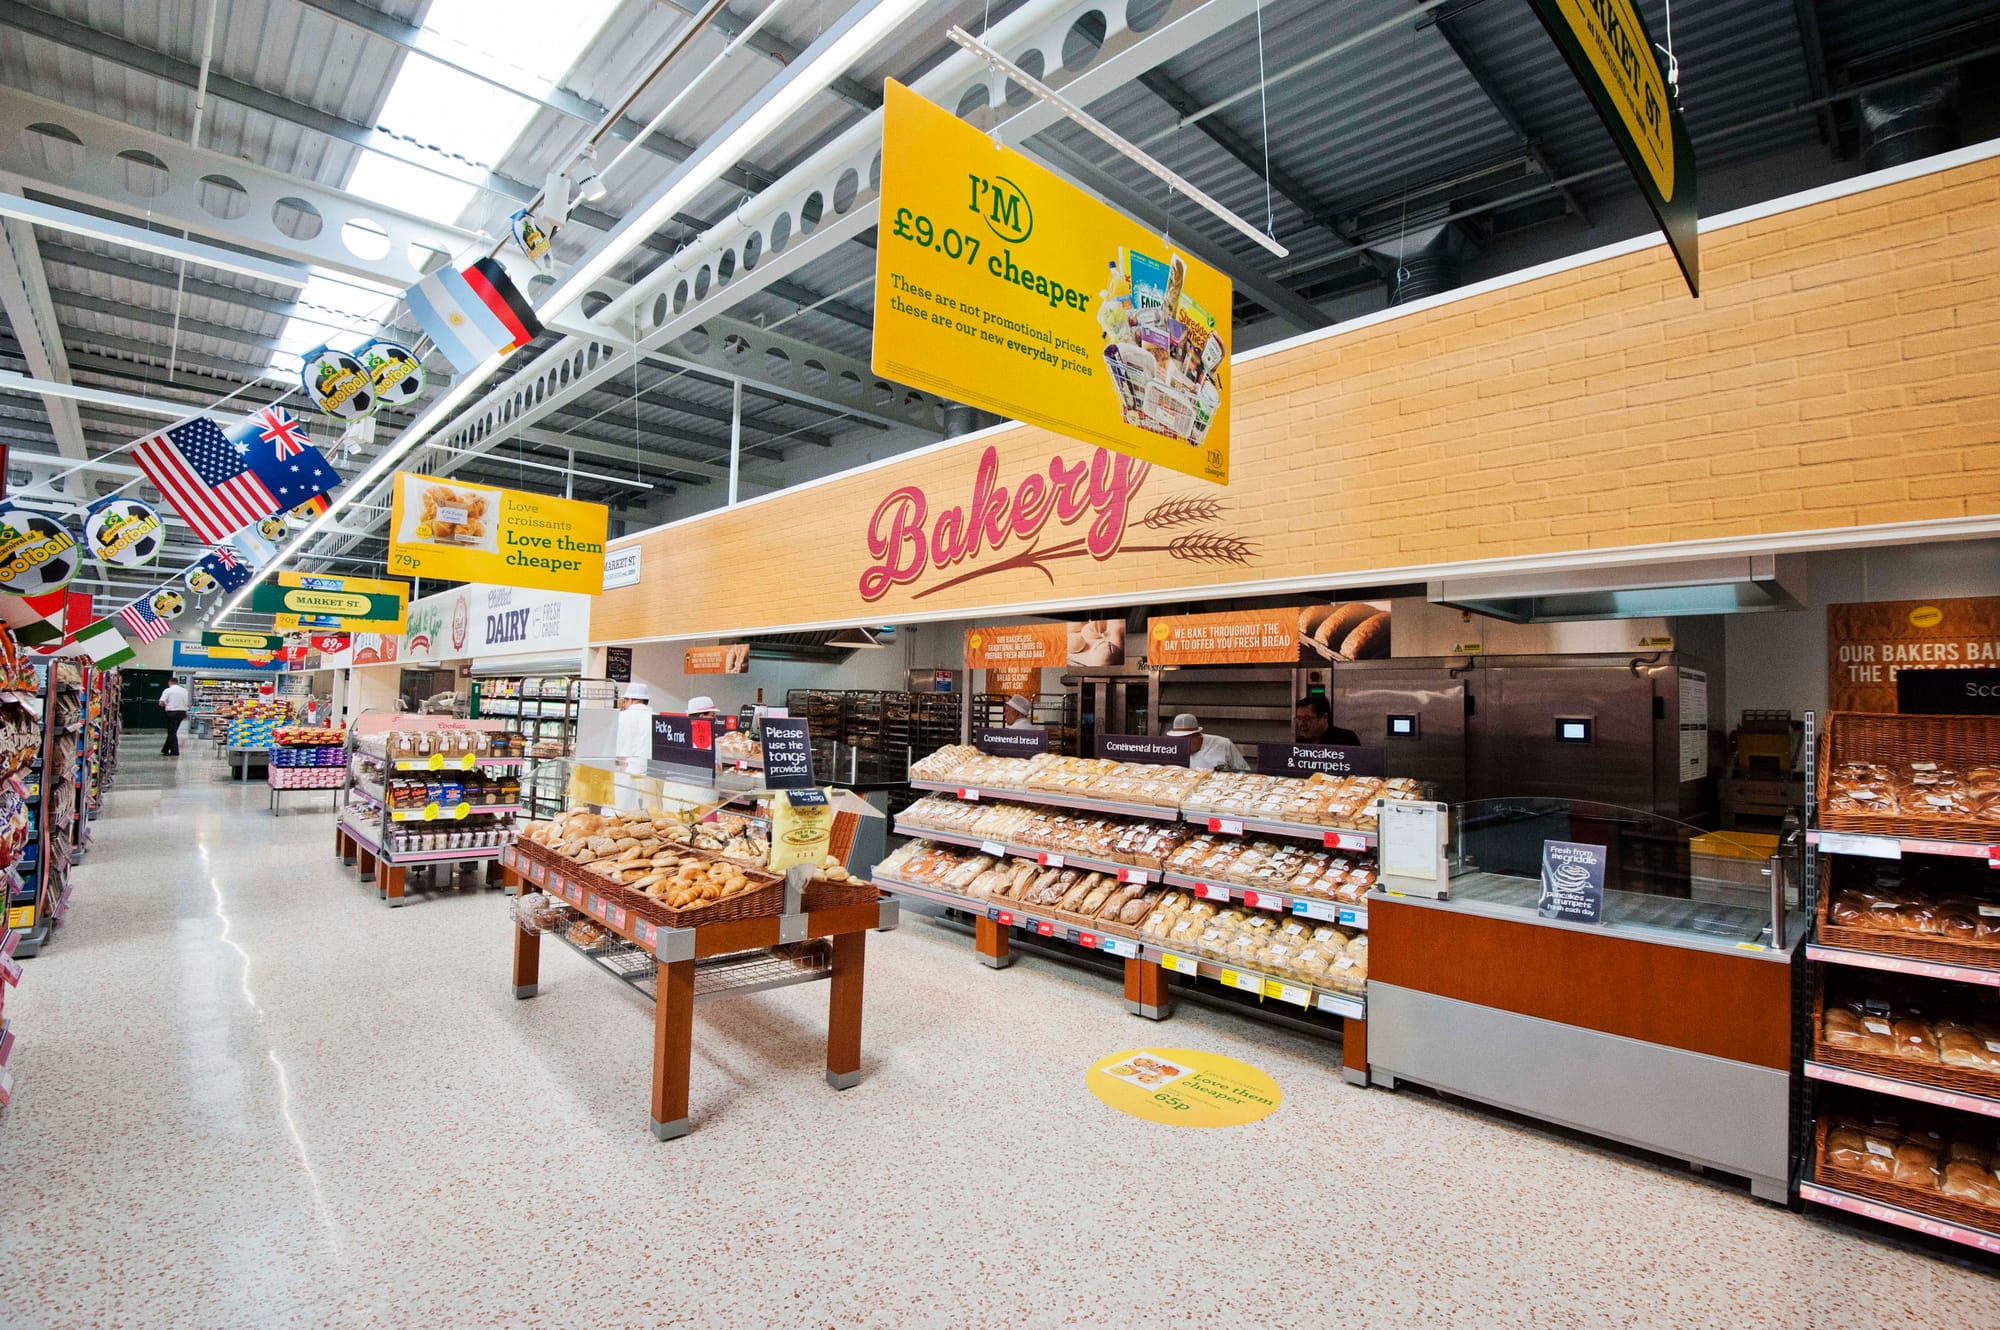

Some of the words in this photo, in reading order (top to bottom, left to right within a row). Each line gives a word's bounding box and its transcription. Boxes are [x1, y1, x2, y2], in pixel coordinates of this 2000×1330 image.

[1646, 81, 1663, 149] ST.
[893, 208, 980, 265] £9.07
[988, 249, 1090, 312] cheaper
[891, 272, 932, 300] These
[935, 294, 956, 309] are
[959, 302, 980, 318] not
[983, 311, 1052, 344] promotional
[1055, 337, 1089, 359] prices,
[890, 295, 928, 320] these
[931, 313, 952, 328] are
[955, 322, 977, 336] our
[980, 330, 1004, 346] new
[1007, 340, 1059, 366] everyday
[1061, 358, 1092, 376] prices
[1187, 327, 1205, 349] Whea
[375, 357, 419, 396] ootball
[319, 370, 370, 413] football
[508, 500, 539, 513] Love
[507, 517, 572, 531] croissants
[859, 445, 1152, 602] Bakery
[27, 532, 36, 540] of
[96, 514, 160, 560] football
[506, 530, 552, 548] Love
[557, 535, 603, 554] them
[0, 532, 76, 582] ootball
[395, 554, 421, 569] 79p
[506, 550, 582, 573] cheaper
[296, 596, 344, 607] MARKET
[542, 602, 561, 622] FRESH
[280, 616, 296, 625] 70p
[486, 608, 530, 645] DAIRY
[1174, 628, 1185, 639] WE
[1187, 627, 1207, 638] BAKE
[1209, 624, 1262, 637] THROUGHOUT
[1263, 623, 1279, 634] THE
[321, 638, 343, 650] 89p
[1164, 639, 1179, 651] DAY
[1181, 639, 1189, 650] TO
[1191, 638, 1214, 650] OFFER
[1217, 638, 1232, 649] YOU
[1234, 636, 1259, 648] FRESH
[1262, 635, 1291, 647] BREAD
[1003, 651, 1018, 659] FRESH
[1017, 650, 1033, 658] BREAD
[1839, 645, 1875, 663] OUR
[1882, 643, 1959, 662] BAKERS
[1848, 665, 1882, 682] THE
[655, 720, 668, 734] Pick
[667, 725, 673, 741] &
[673, 731, 686, 743] mix
[766, 726, 804, 739] Please
[983, 734, 1019, 744] Continental
[1019, 735, 1039, 745] bread
[768, 742, 786, 750] use
[788, 741, 804, 750] the
[1106, 741, 1151, 753] Continental
[1152, 743, 1177, 754] bread
[1292, 746, 1345, 760] Pancakes
[769, 751, 806, 765] tongs
[1287, 757, 1295, 768] &
[1297, 759, 1351, 772] crumpets
[770, 765, 808, 775] provided
[1550, 846, 1572, 854] Fresh
[1573, 848, 1593, 857] from
[1562, 854, 1597, 865] griddle
[1546, 891, 1584, 901] pancakes
[1553, 898, 1592, 909] crumpets
[1565, 906, 1581, 914] each
[1582, 908, 1595, 917] day
[1182, 1080, 1247, 1105] cheaper
[1193, 1074, 1229, 1090] Love
[1232, 1088, 1273, 1106] them
[1154, 1093, 1190, 1111] 65p
